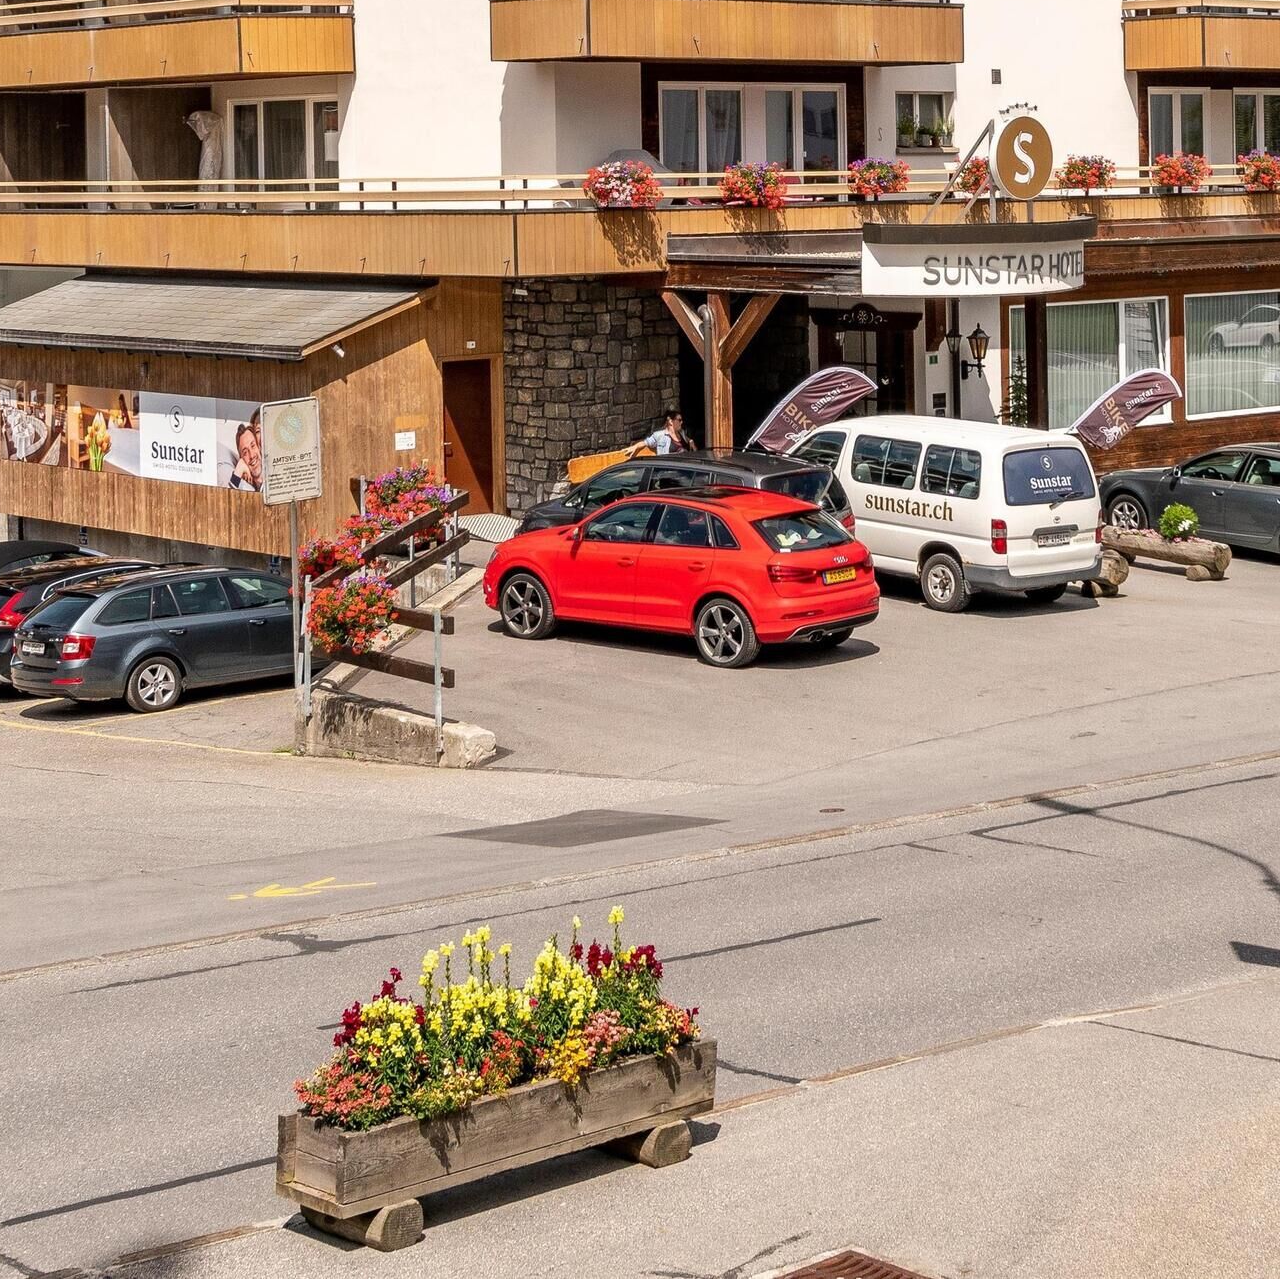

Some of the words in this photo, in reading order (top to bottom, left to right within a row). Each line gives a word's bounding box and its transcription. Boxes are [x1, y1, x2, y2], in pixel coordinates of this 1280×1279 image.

[1013, 130, 1036, 185] S
[923, 254, 1045, 286] SUNSTAR
[810, 386, 842, 413] Sunstar
[1125, 386, 1155, 410] Sunstar
[1104, 397, 1130, 438] BIKE
[151, 441, 205, 464] Sunstar
[1030, 475, 1072, 489] Sunstar
[864, 493, 954, 522] sunstar.ch
